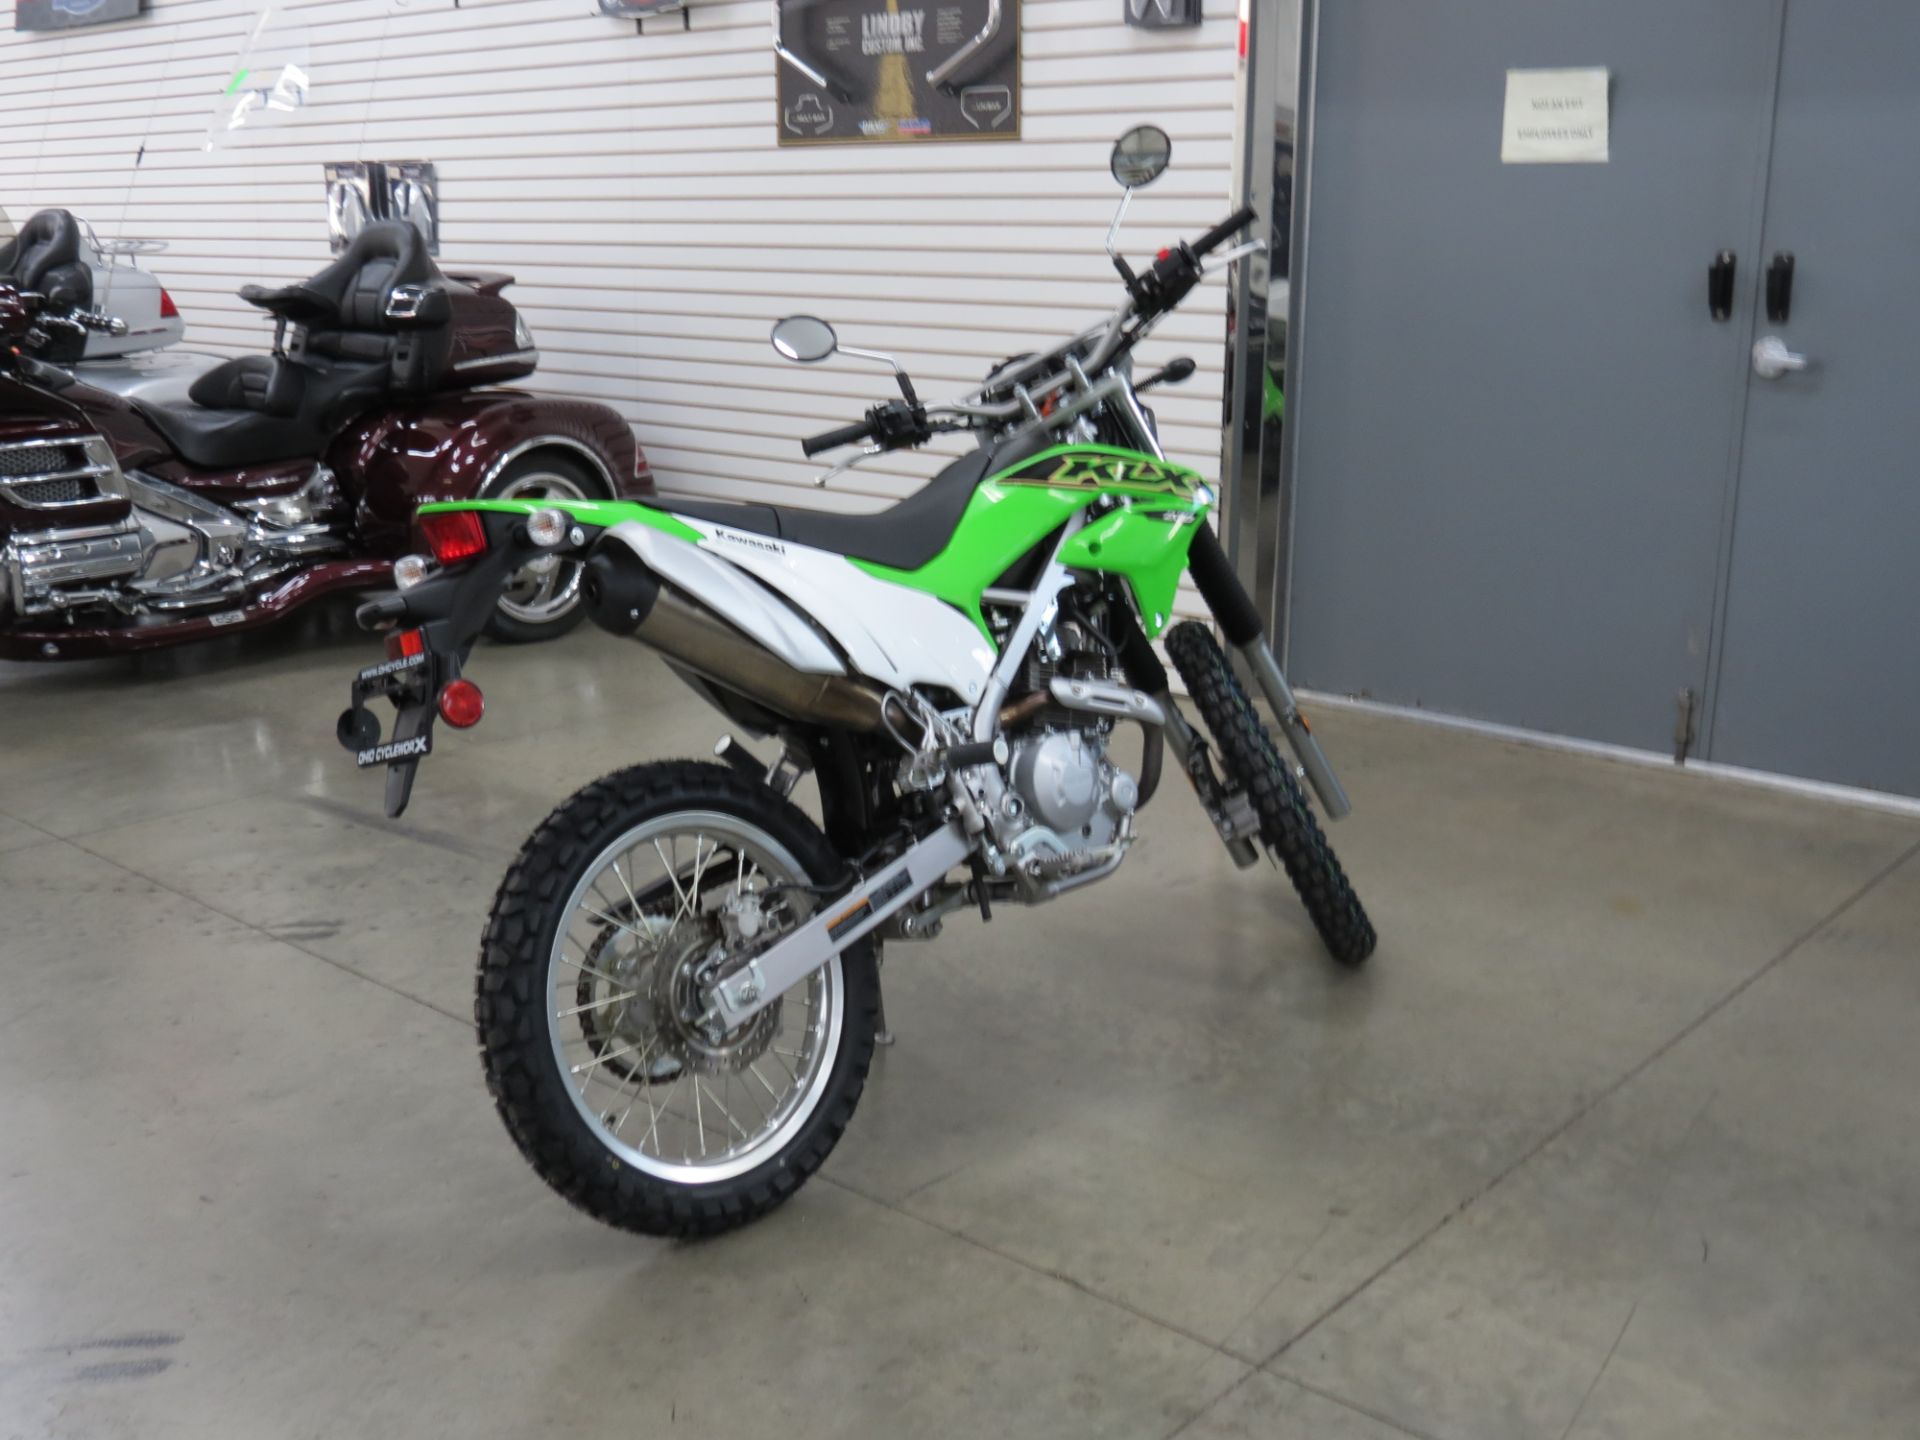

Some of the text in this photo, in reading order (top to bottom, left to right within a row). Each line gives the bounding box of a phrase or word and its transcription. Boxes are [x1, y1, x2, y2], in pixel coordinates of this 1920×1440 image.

[861, 8, 925, 39] LINDBY
[861, 37, 904, 56] CUSTOM
[1049, 455, 1196, 500] KLX
[715, 528, 786, 555] Kawasaki
[358, 746, 376, 766] OHIO
